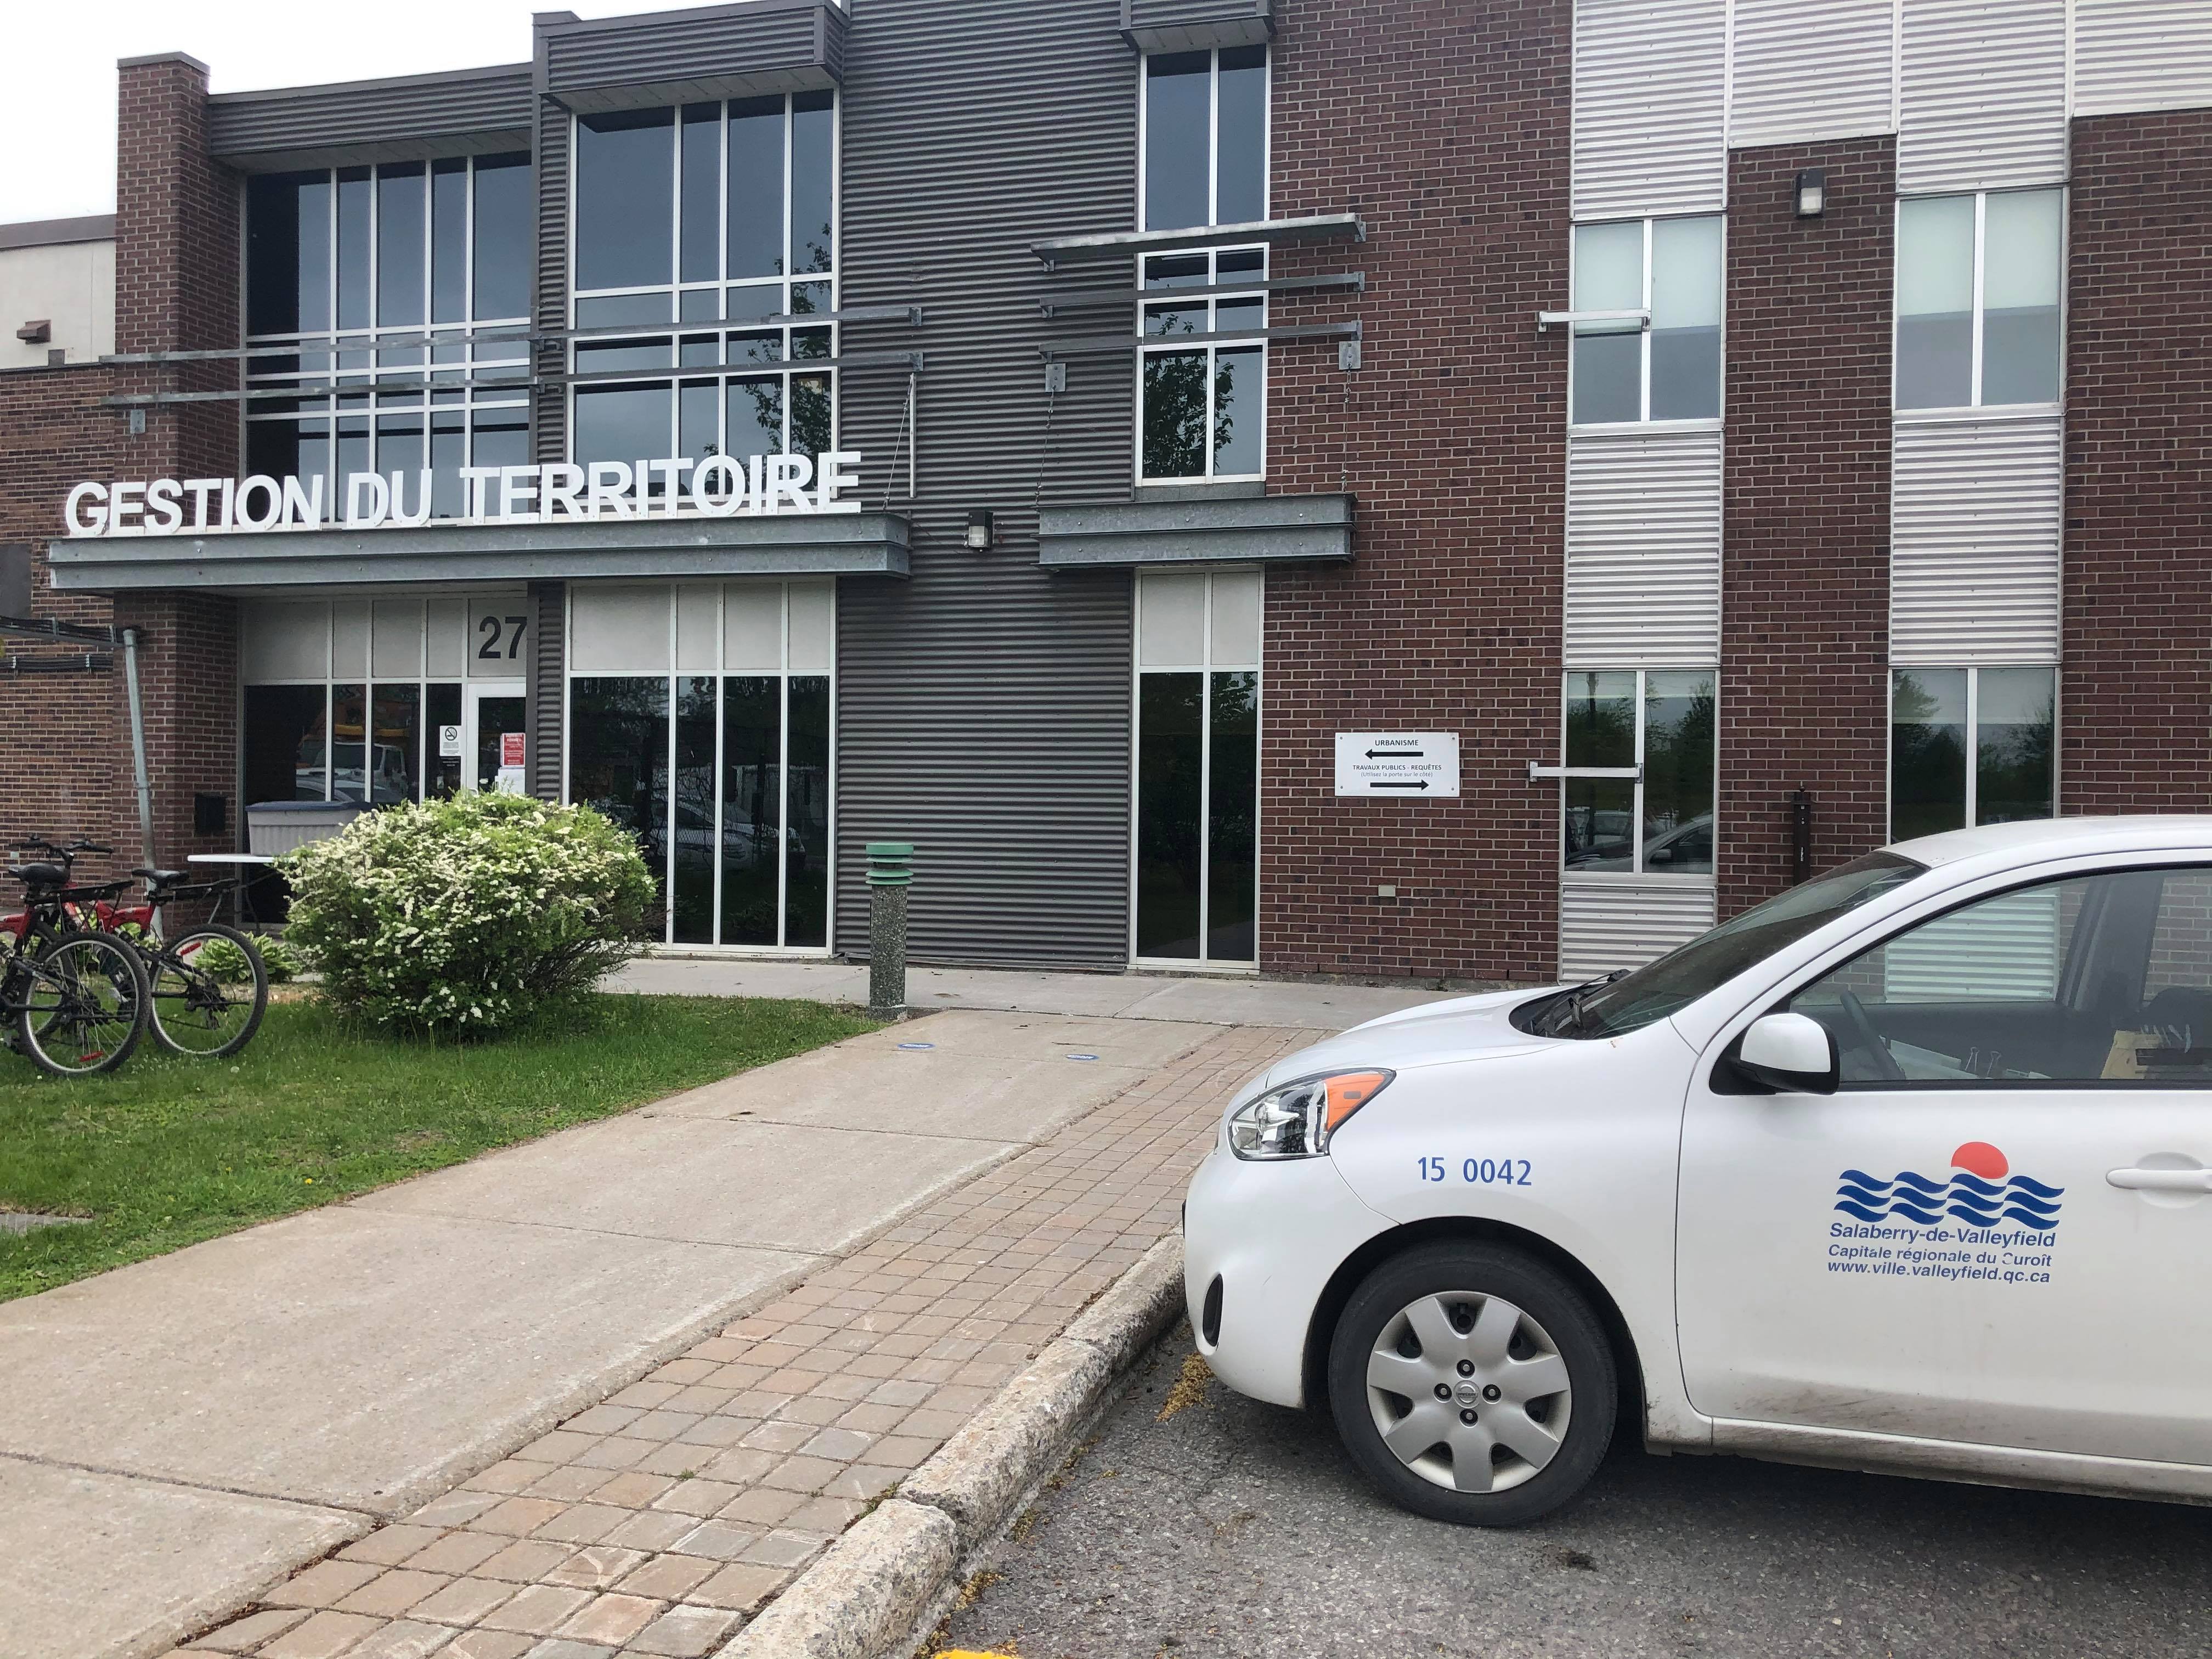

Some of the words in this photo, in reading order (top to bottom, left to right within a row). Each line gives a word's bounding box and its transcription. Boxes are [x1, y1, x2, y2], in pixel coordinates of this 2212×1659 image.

[65, 474, 324, 536] GESTION
[346, 469, 432, 529] DU
[459, 451, 861, 525] TERRITOIRE
[478, 616, 527, 659] 27
[1418, 1157, 1446, 1182] 15
[1463, 1158, 1532, 1186] 0042
[1830, 1222, 2056, 1249] Salaberry-de-Valleyfield
[1829, 1244, 1892, 1260] Capitale
[1897, 1248, 1971, 1263] régionale
[1976, 1251, 1997, 1264] du
[1828, 1262, 2050, 1284] www.ville.valleyfield.qc.ca
